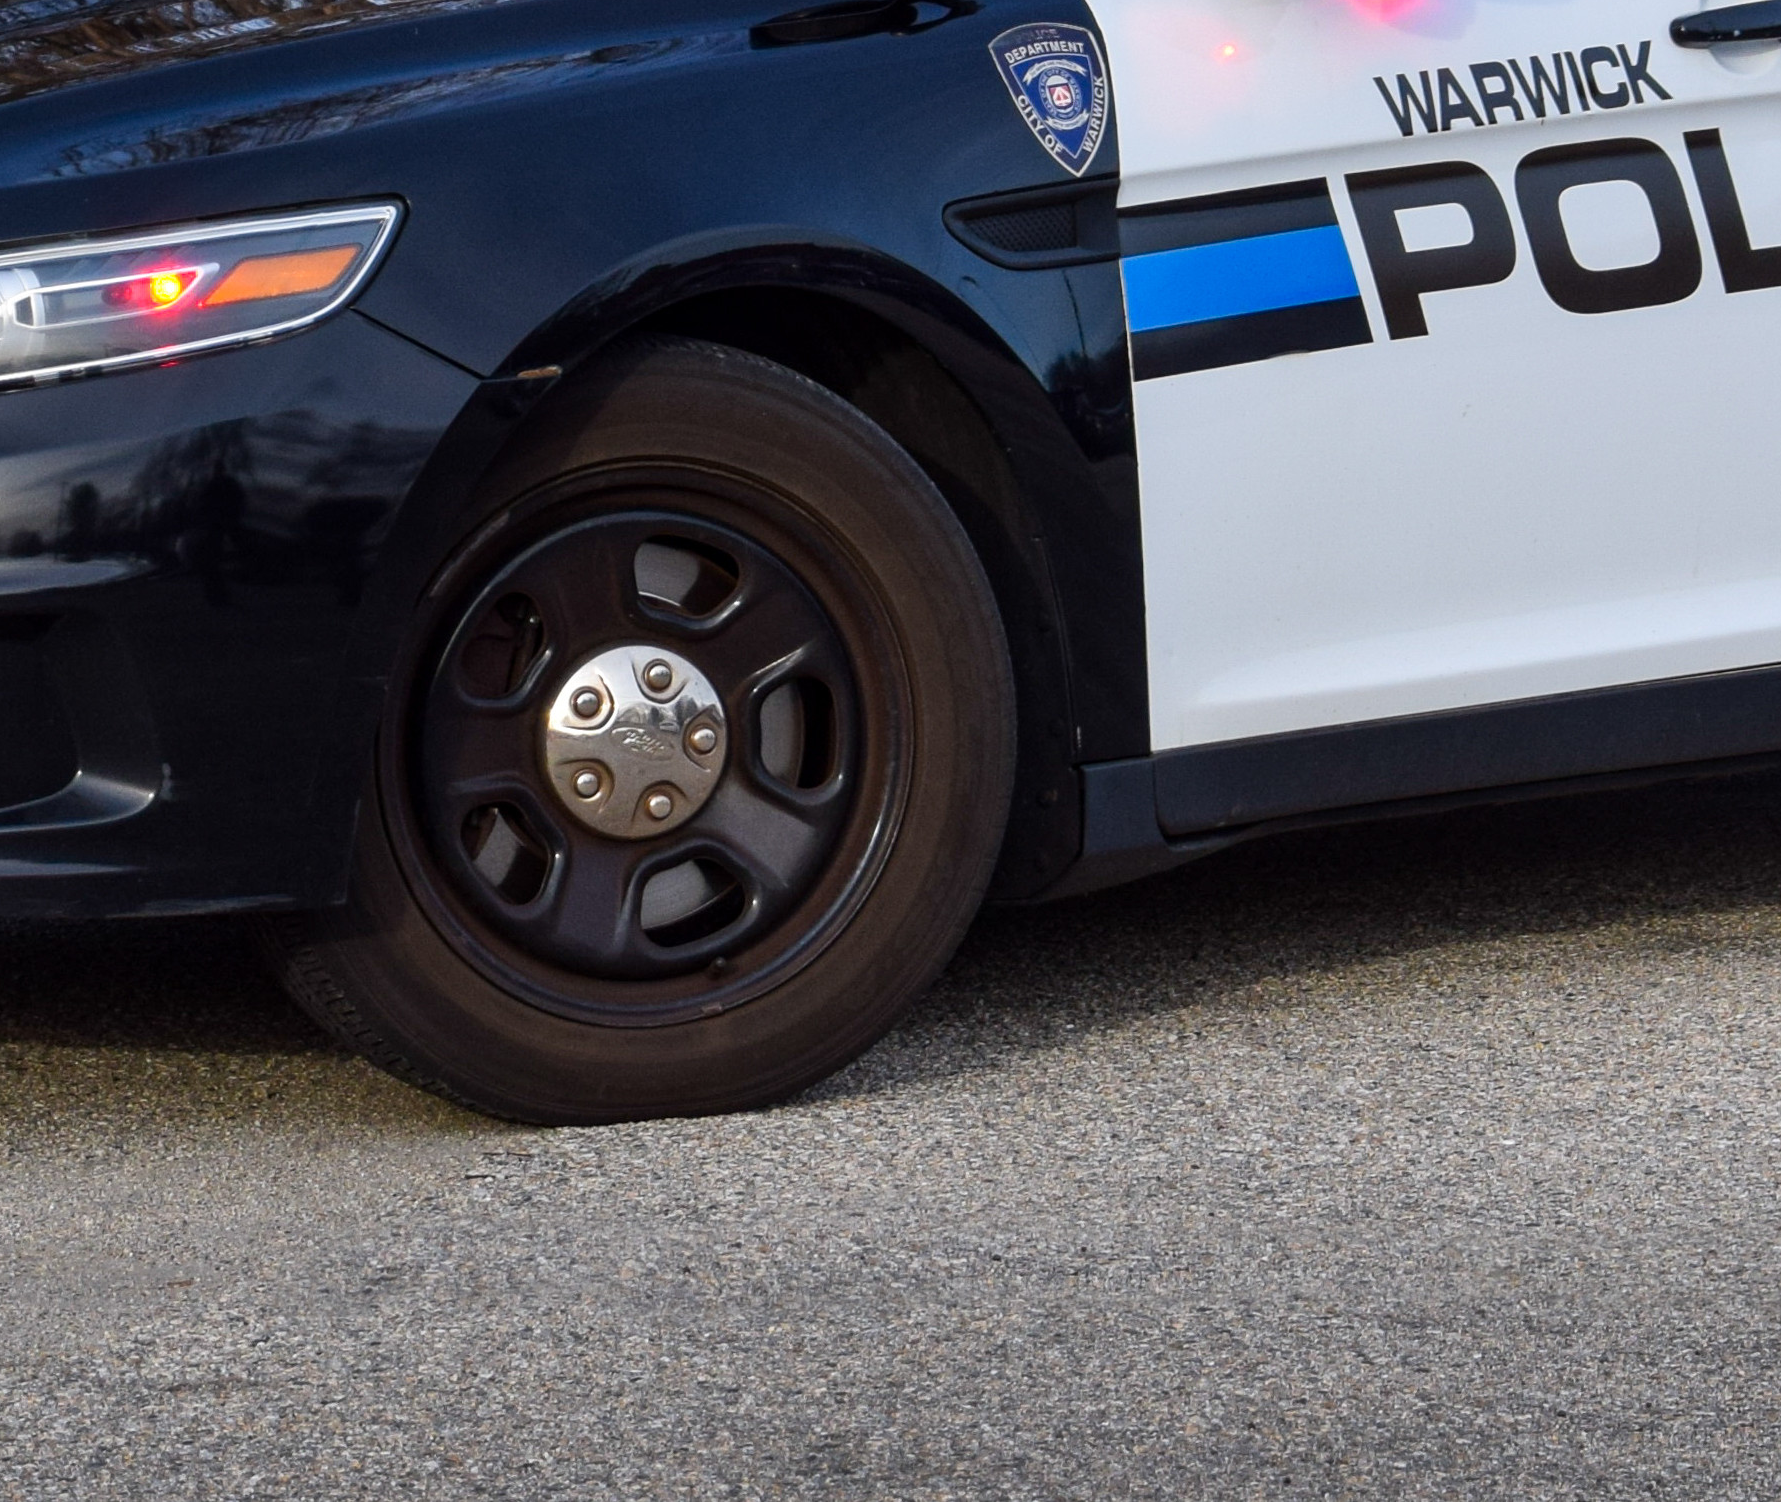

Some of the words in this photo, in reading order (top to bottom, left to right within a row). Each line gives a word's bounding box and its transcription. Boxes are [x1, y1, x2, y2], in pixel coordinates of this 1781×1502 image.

[1004, 41, 1084, 64] DEPARTMENT
[1373, 40, 1673, 136] WARWICK
[1017, 95, 1045, 130] CITY
[1045, 134, 1064, 155] OF
[1082, 76, 1104, 153] WARWICK
